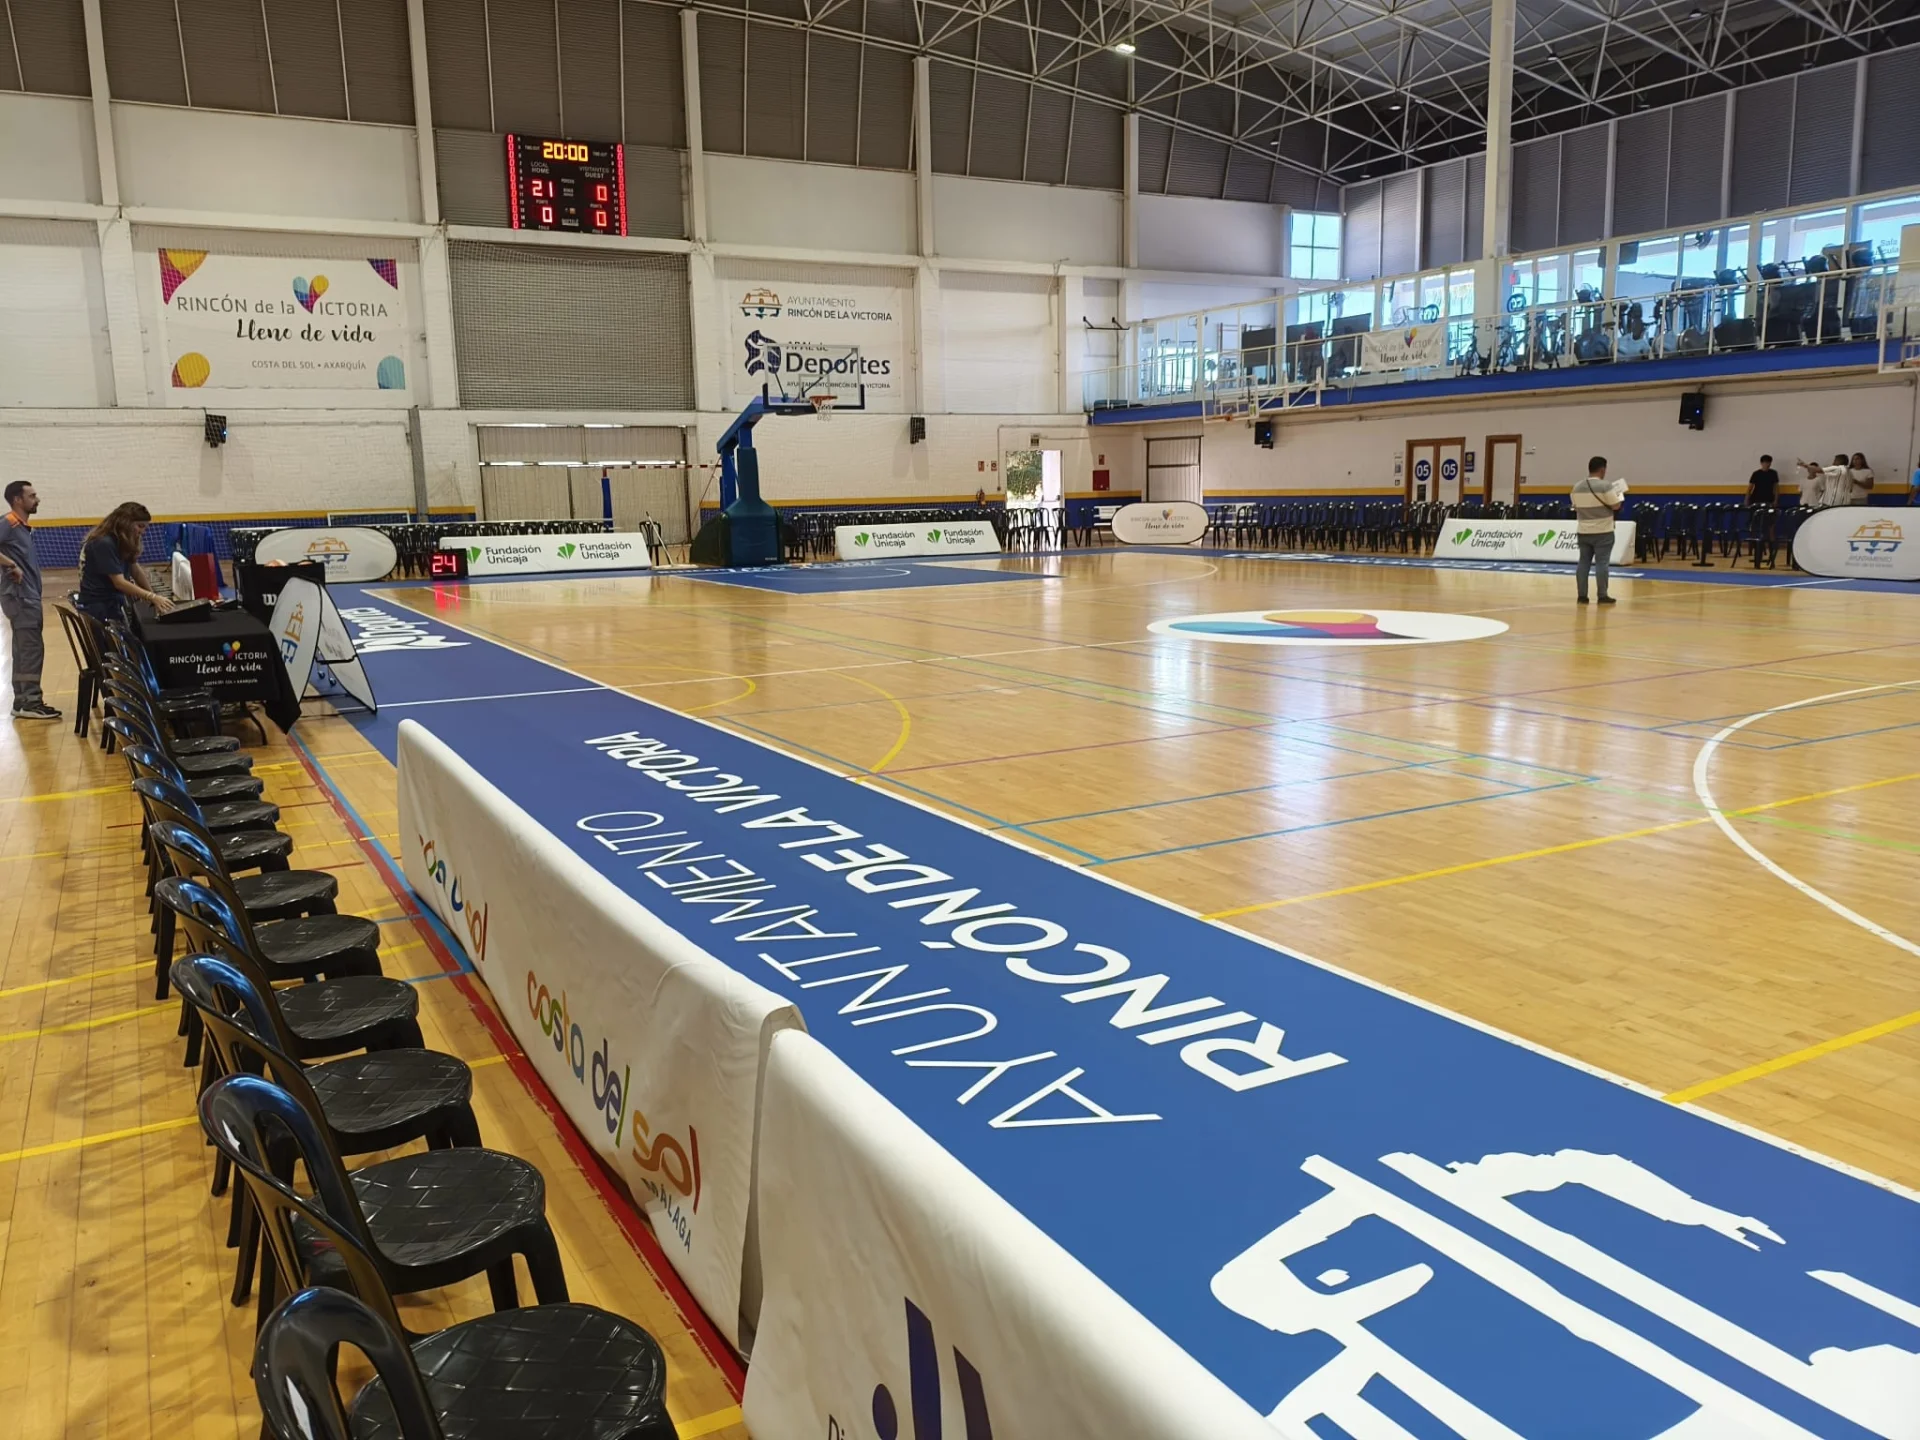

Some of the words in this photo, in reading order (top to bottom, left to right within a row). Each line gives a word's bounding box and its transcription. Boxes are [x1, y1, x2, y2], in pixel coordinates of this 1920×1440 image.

[543, 142, 588, 161] 20:00
[532, 180, 553, 198] 21
[597, 186, 608, 201] 0
[542, 207, 552, 222] 0
[596, 211, 607, 226] 0
[177, 293, 248, 313] RINCÓN
[254, 300, 274, 314] de
[280, 300, 295, 315] la
[787, 296, 856, 308] AYUNTAMIENTO
[788, 308, 822, 318] RINCÓN
[824, 310, 836, 318] DE
[838, 312, 850, 320] LA
[851, 312, 892, 321] VICTORIA
[236, 318, 292, 342] Lleno
[300, 322, 324, 342] de
[331, 324, 376, 343] vida
[252, 360, 280, 368] COSTA
[282, 360, 298, 369] DEL
[300, 361, 316, 370] SOL
[324, 360, 366, 371] AXARQUÍA
[786, 352, 890, 374] Deportes
[1416, 464, 1429, 477] 05
[1443, 464, 1456, 476] 05
[872, 531, 916, 540] Fundación
[944, 528, 984, 537] Fundación
[1474, 530, 1523, 539] Fundación
[579, 540, 632, 552] Fundación
[874, 539, 906, 548] Unicaja
[946, 536, 976, 545] Unicaja
[1471, 539, 1506, 550] Unicaja
[1554, 540, 1580, 550] Unic
[486, 546, 542, 556] Fundación
[582, 551, 620, 560] Unicaja
[432, 556, 456, 572] 24
[488, 554, 528, 565] Unicaja
[170, 654, 202, 664] RINCÓN
[226, 664, 238, 672] de
[241, 662, 262, 672] vida
[584, 731, 781, 814] VICTORIA
[576, 811, 1163, 1129] AYUNTAMIENTO
[887, 888, 1349, 1092] RINCÓN
[527, 970, 585, 1085] costa
[592, 1038, 630, 1148] del
[632, 1110, 701, 1215] sol
